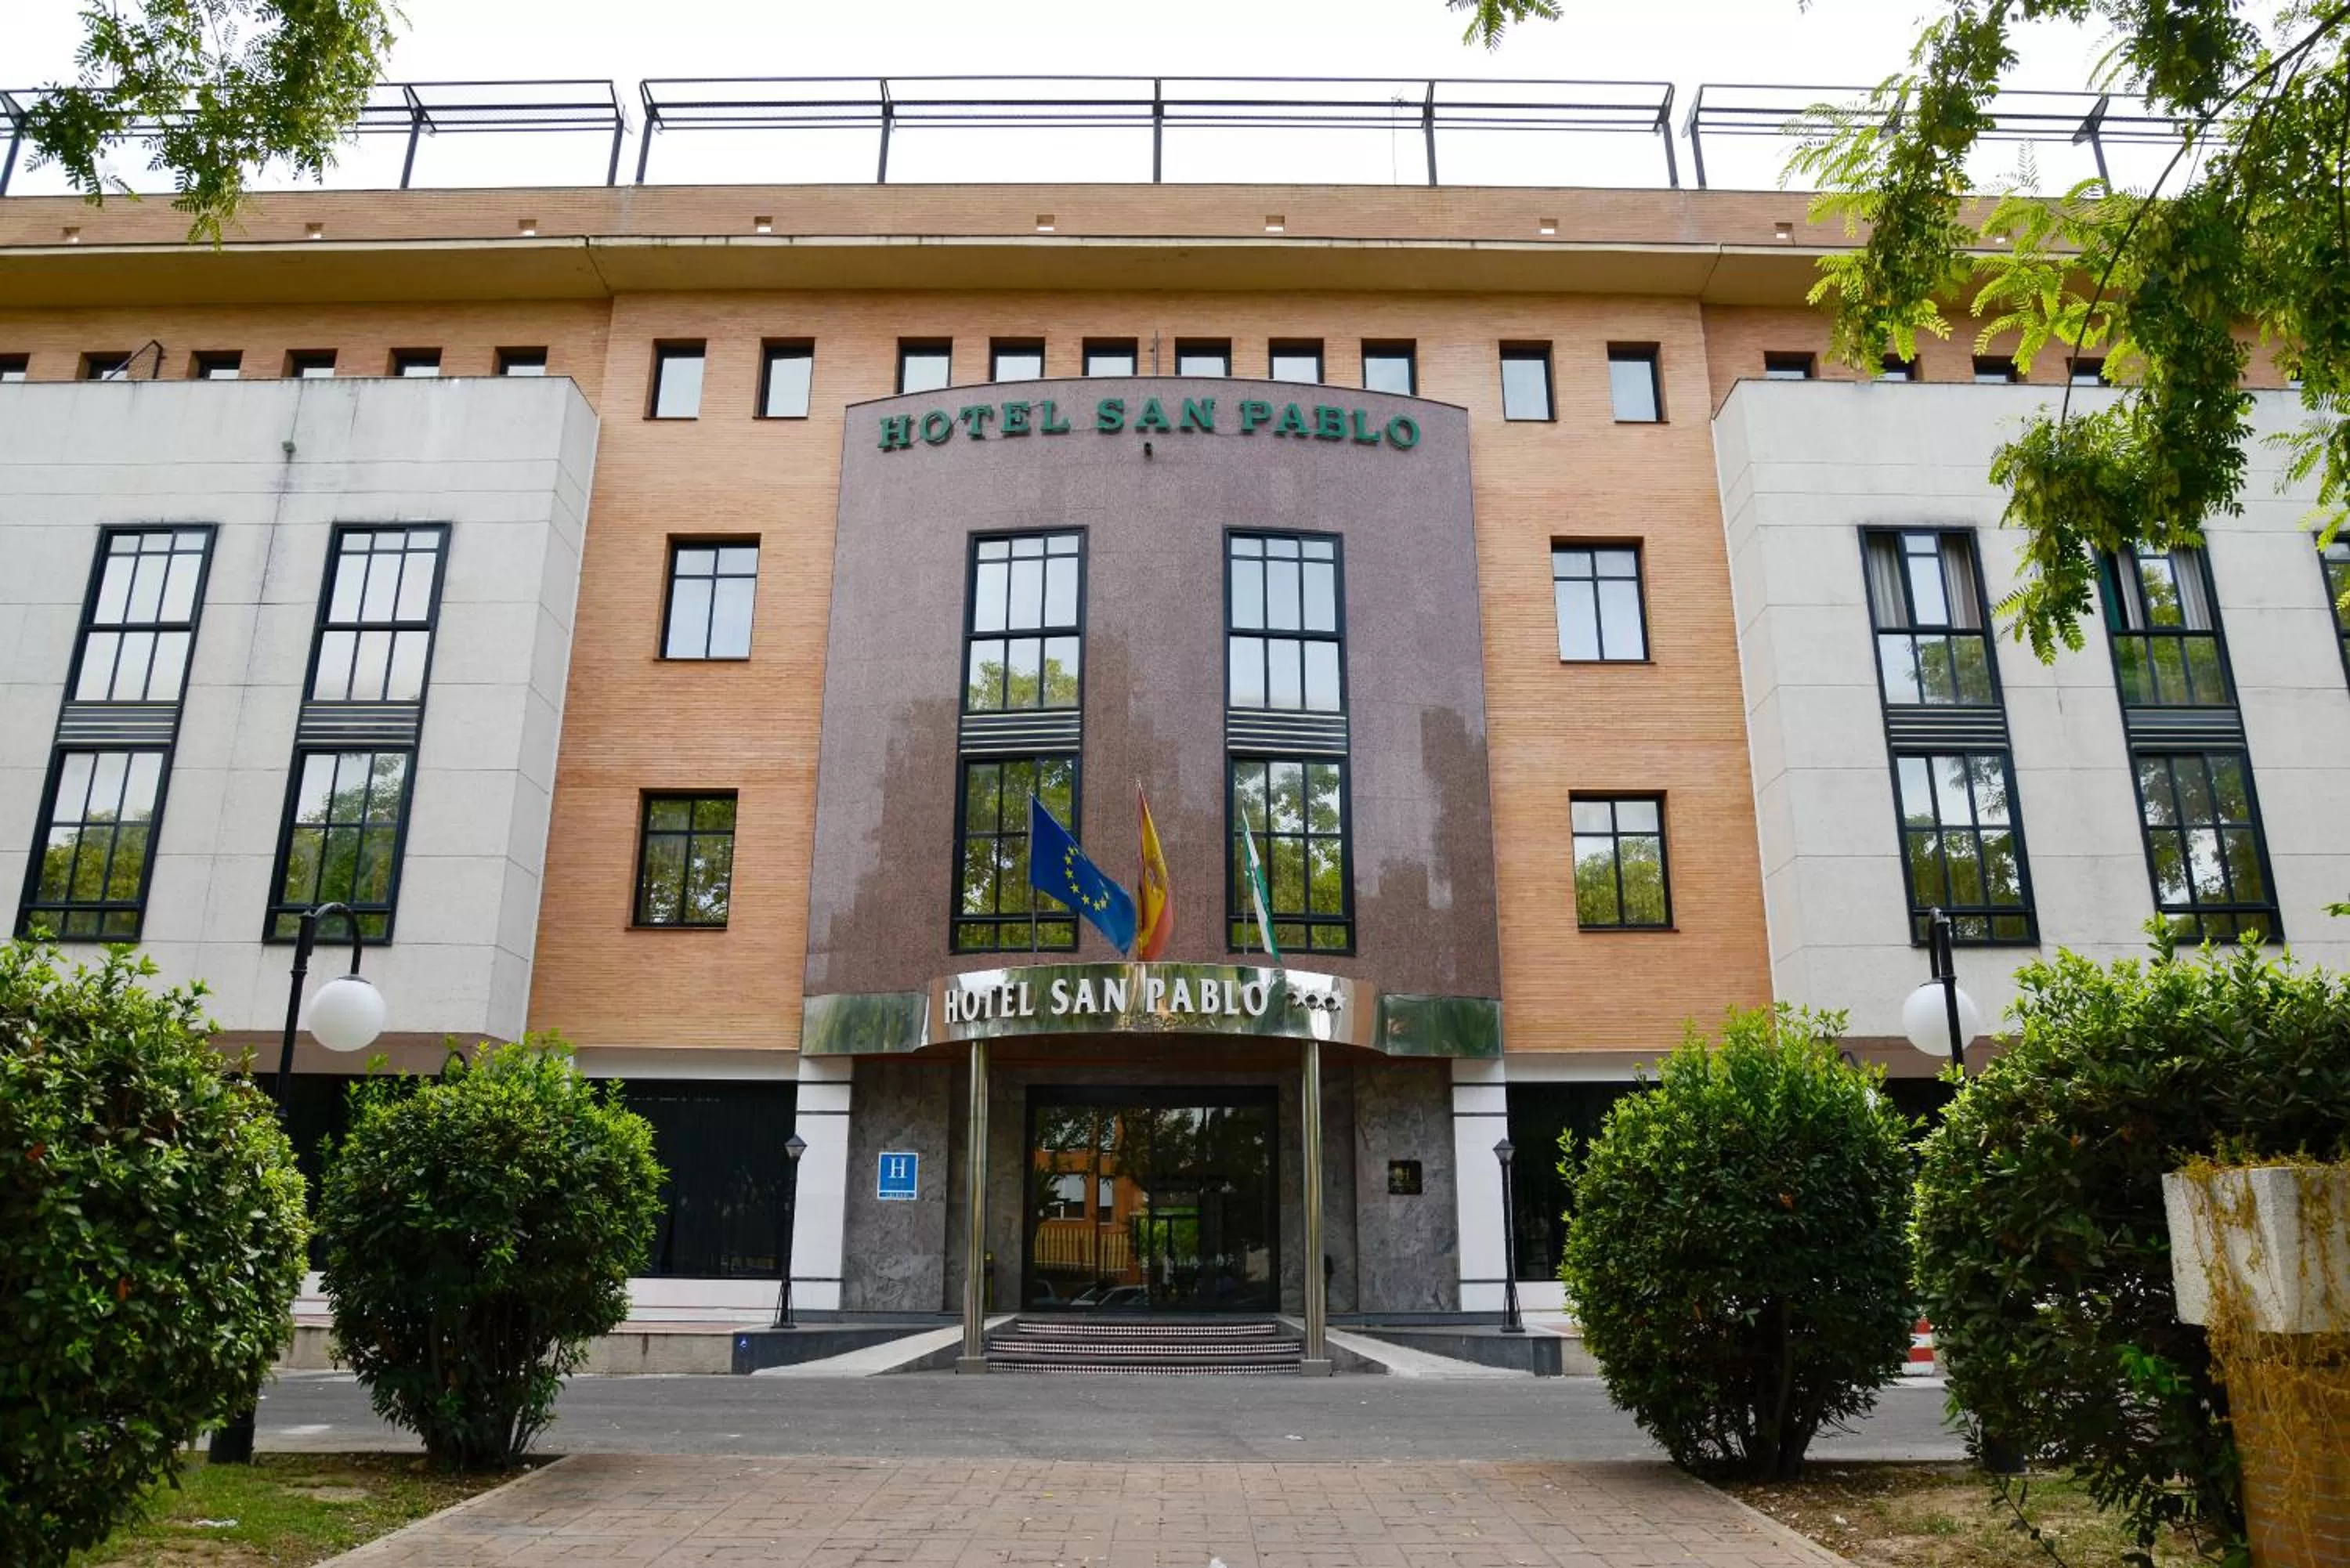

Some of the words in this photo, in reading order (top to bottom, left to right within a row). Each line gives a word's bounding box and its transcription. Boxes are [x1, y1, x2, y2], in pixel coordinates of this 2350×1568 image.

[877, 399, 1070, 450] HOTEL
[1094, 397, 1215, 431] SAN
[1240, 399, 1421, 450] PABLO
[944, 981, 1034, 1024] HOTEL
[1050, 977, 1128, 1016] SAN
[1145, 977, 1269, 1017] PABLO
[888, 1157, 908, 1179] H
